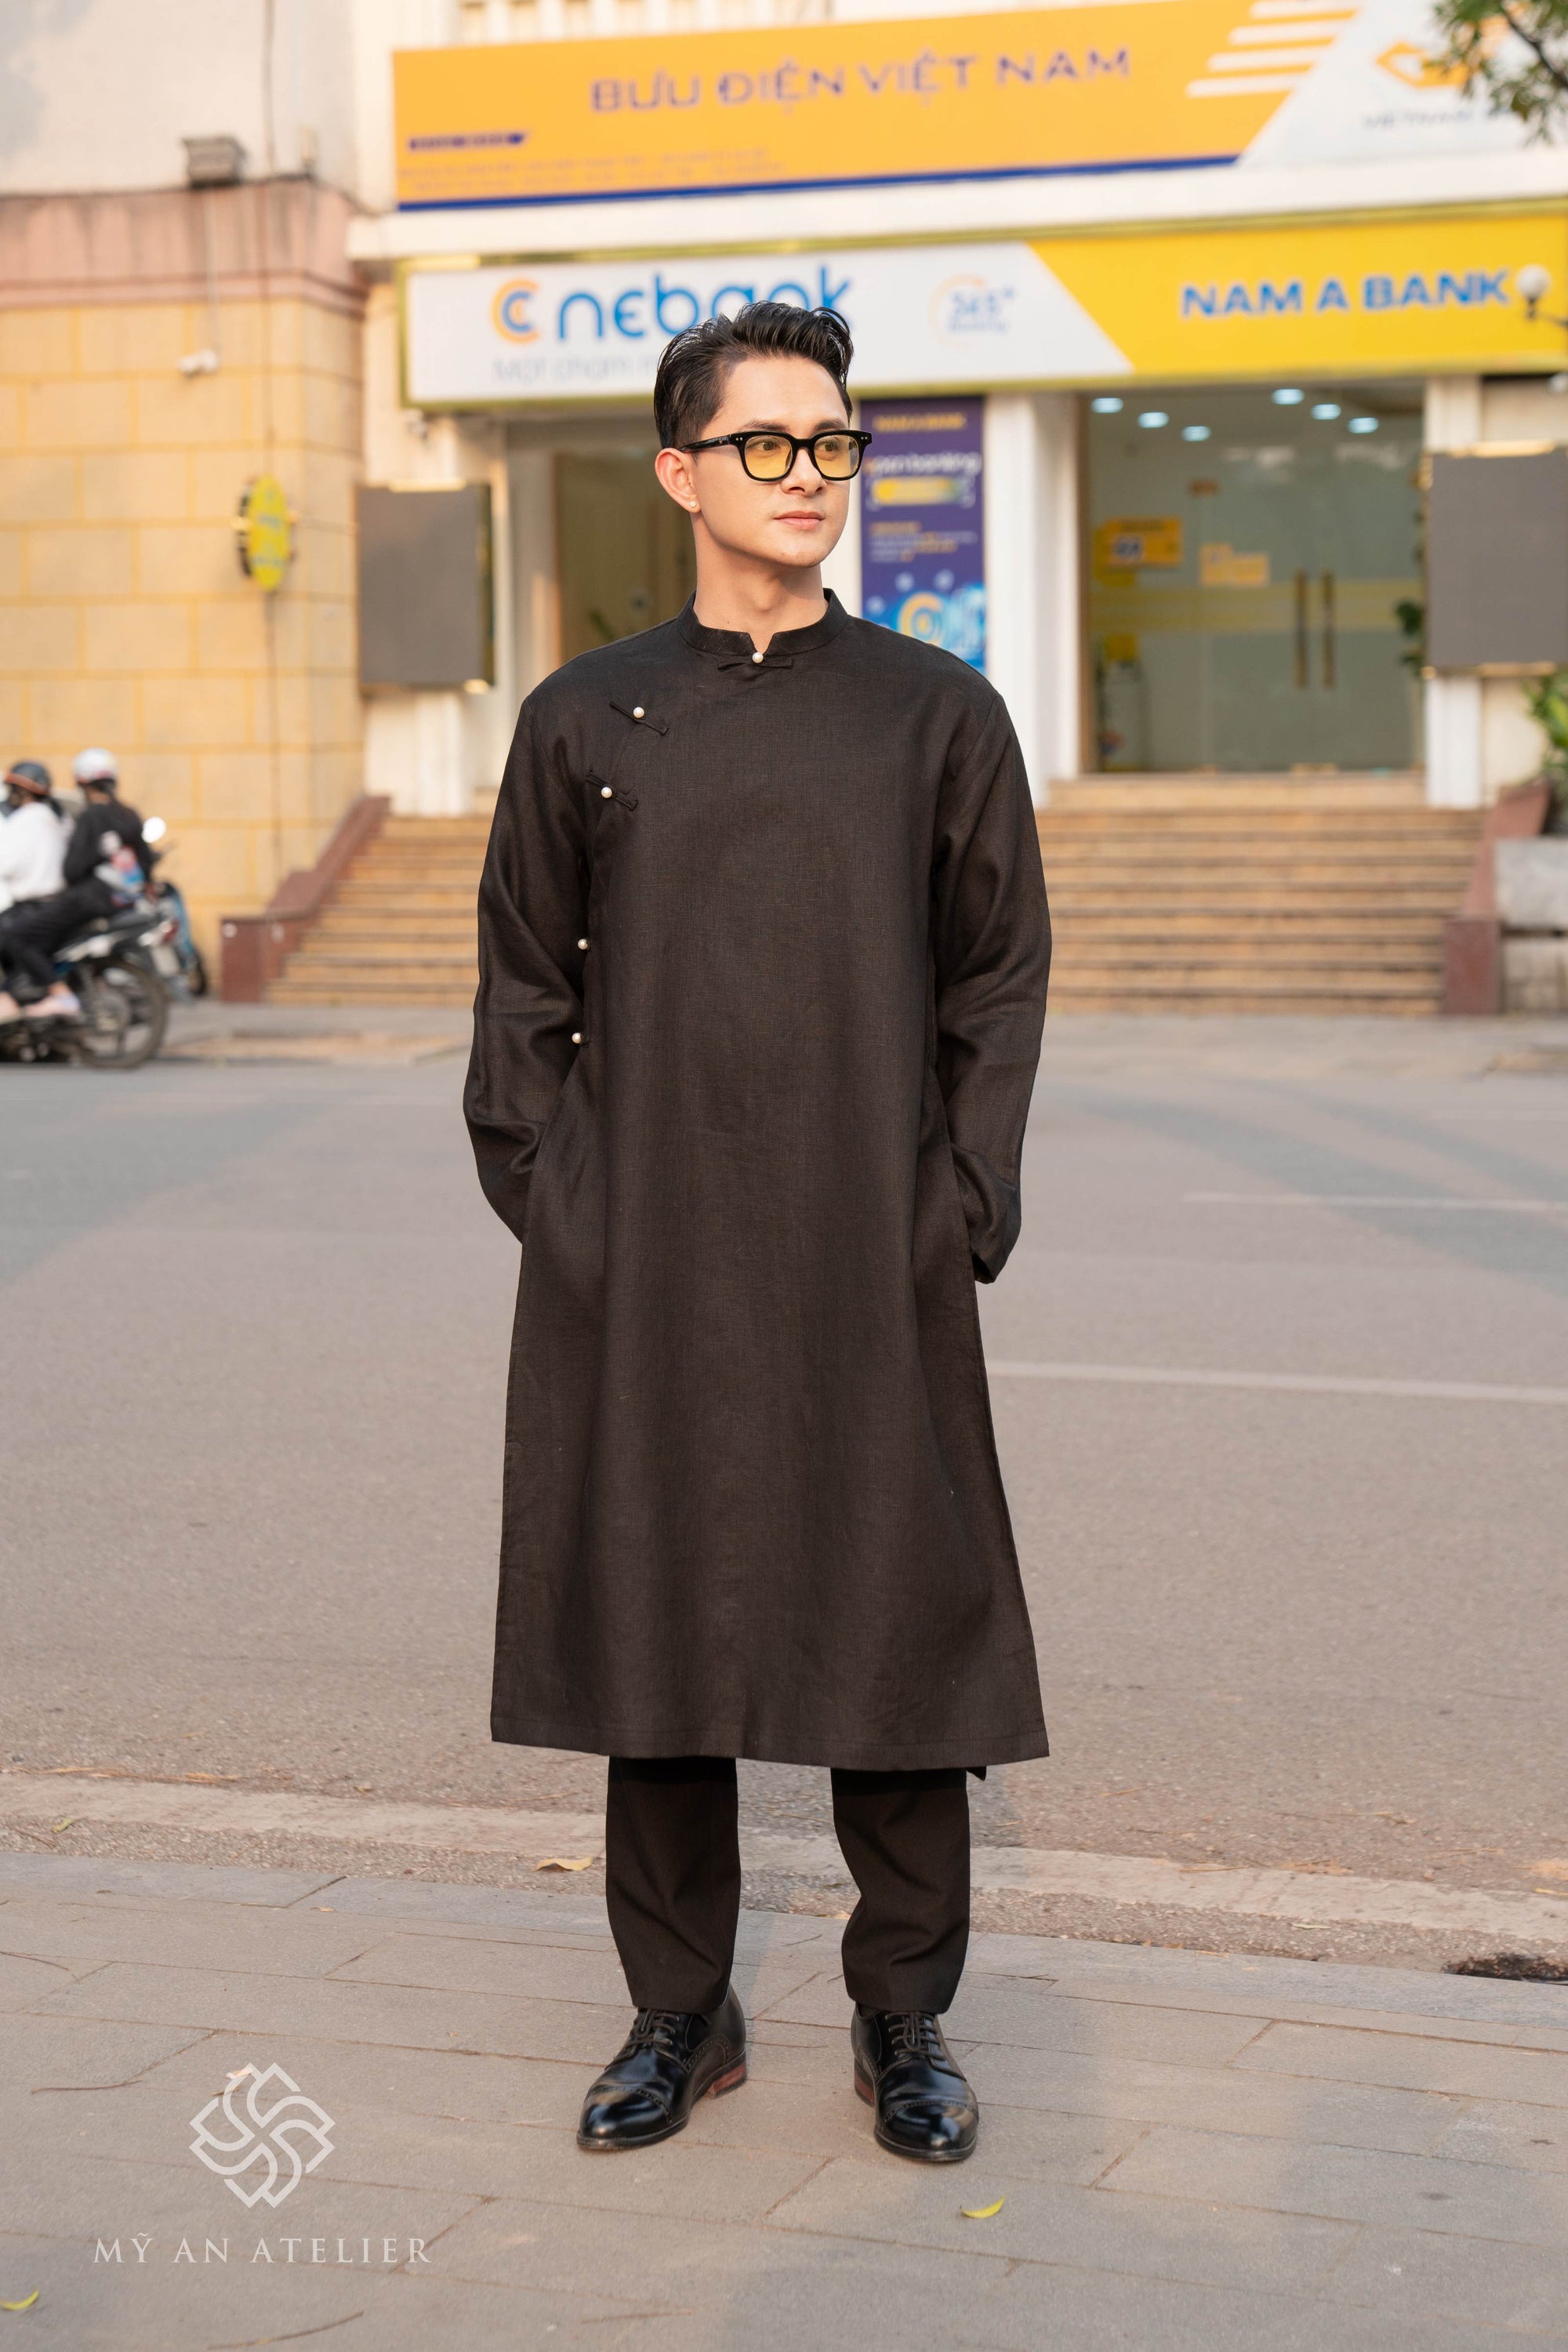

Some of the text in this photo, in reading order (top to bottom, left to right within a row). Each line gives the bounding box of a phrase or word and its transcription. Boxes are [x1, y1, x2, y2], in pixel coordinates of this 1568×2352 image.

[591, 45, 1131, 115] BƯU ĐIỆN VIỆT NAM
[1181, 270, 1510, 318] NAM A BANK
